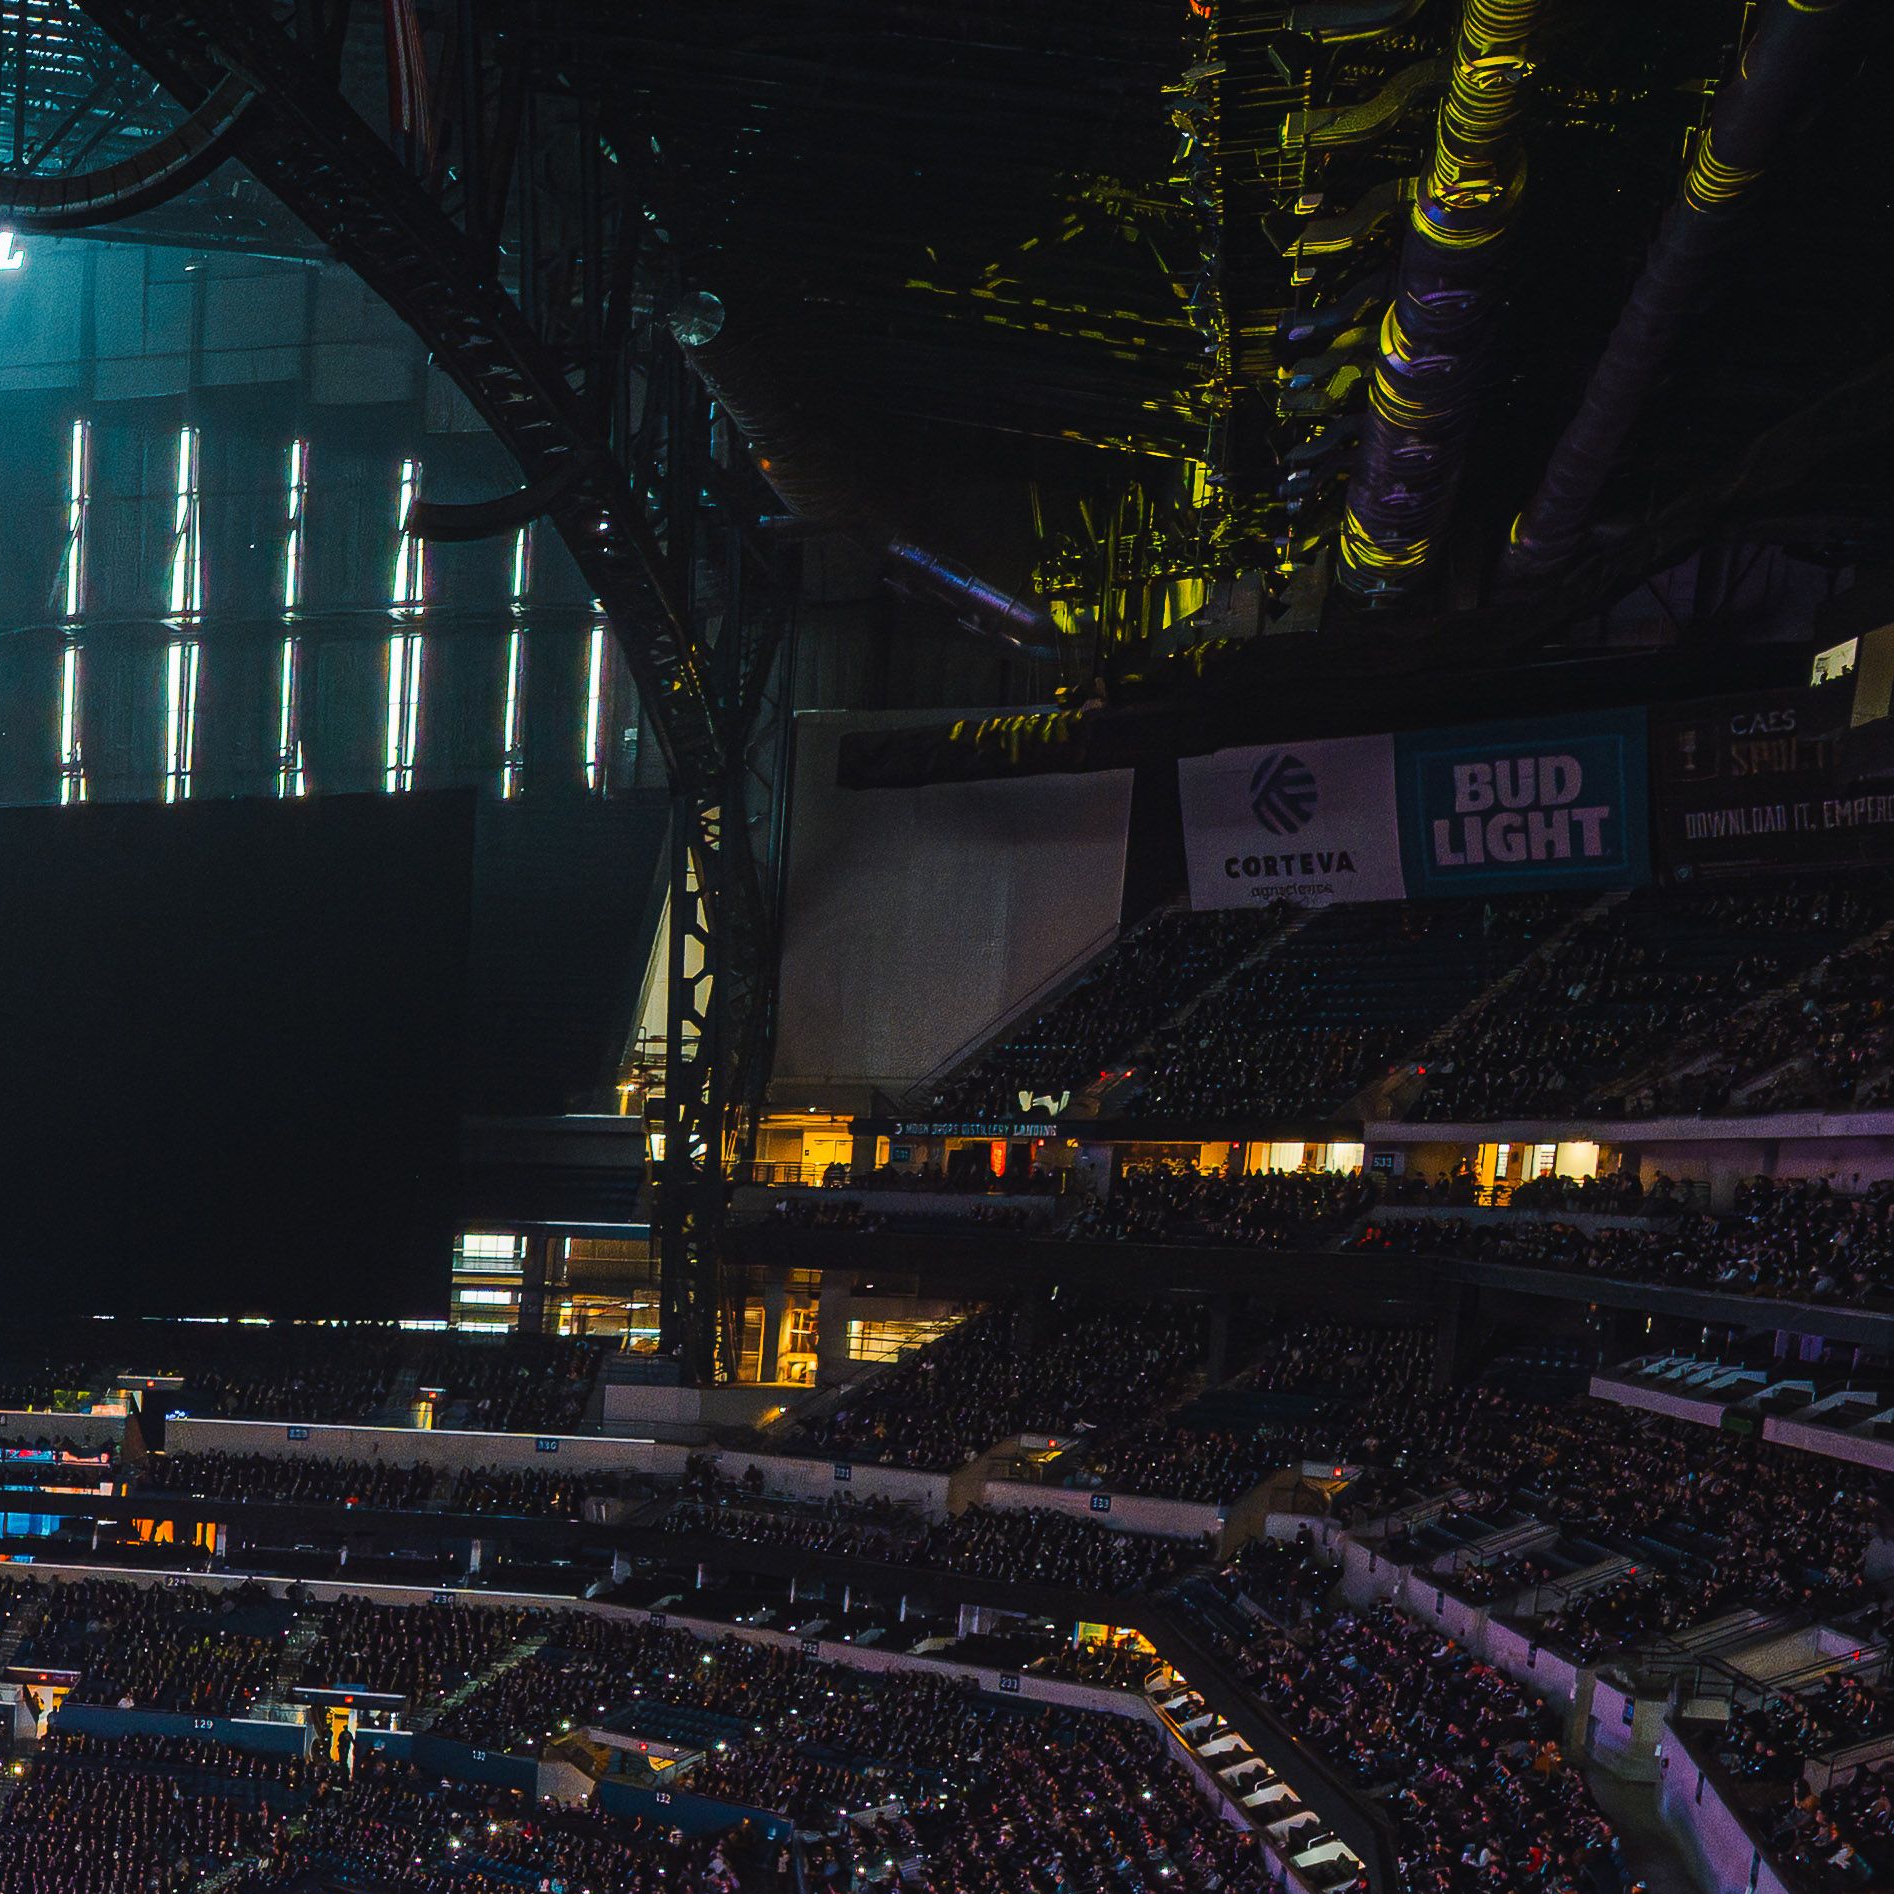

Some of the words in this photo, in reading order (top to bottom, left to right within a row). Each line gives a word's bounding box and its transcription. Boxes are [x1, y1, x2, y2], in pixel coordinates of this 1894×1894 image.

[1454, 755, 1582, 813] BUD
[1433, 806, 1610, 866] LIGHT
[1685, 803, 1787, 839] DOWNLOAD
[1794, 803, 1817, 832] IT,
[1225, 851, 1357, 879] CORTEVA
[194, 1718, 214, 1728] 129
